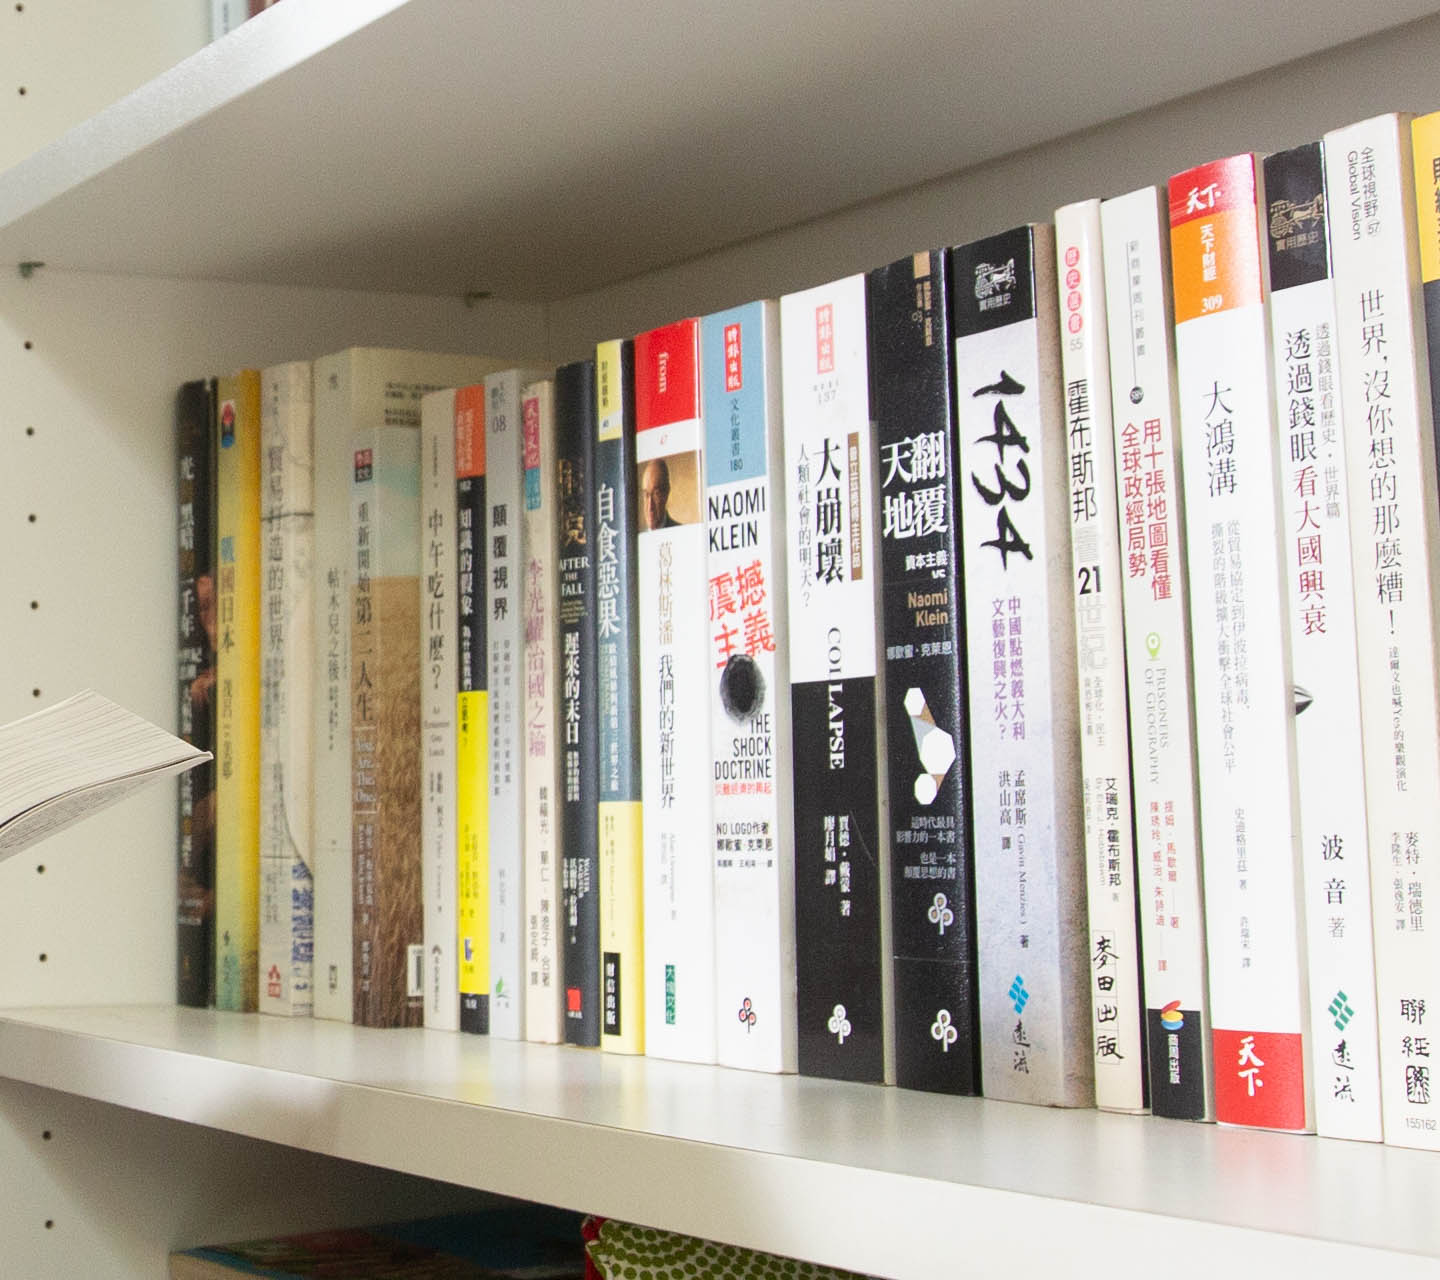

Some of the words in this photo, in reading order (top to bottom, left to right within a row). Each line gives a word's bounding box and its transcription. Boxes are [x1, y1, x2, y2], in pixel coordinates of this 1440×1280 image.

[1186, 182, 1221, 214] 天下
[1361, 146, 1380, 218] 全球視野
[1201, 294, 1223, 313] 309
[657, 351, 670, 393] from
[880, 429, 948, 489] 天翻
[971, 369, 1034, 572] 1434
[1067, 379, 1099, 523] 霍布斯邦
[1202, 380, 1238, 499] 大鴻溝
[708, 486, 767, 521] NAOMI
[814, 438, 845, 585] 大崩壞
[882, 483, 949, 541] 地覆
[1120, 422, 1148, 577] 全球政經局勢
[1143, 417, 1173, 601] 用十張地圖看懂
[1285, 328, 1328, 635] 透過錢眼看大國興衰
[708, 524, 758, 553] KLEIN
[797, 442, 813, 608] 人類社會的明天?
[491, 502, 509, 622] 顛覆視界
[559, 556, 591, 571] AFTER
[561, 581, 585, 596] FALL
[597, 482, 621, 639] 自食惡果
[708, 559, 768, 622] 震撼
[1077, 565, 1102, 595] 21
[427, 508, 447, 690] 中午吃什麼?
[907, 588, 949, 610] Naomi
[915, 609, 949, 628] Klein
[713, 610, 777, 669] 主義
[992, 597, 1008, 740] 文藝復興之火?
[1008, 595, 1026, 741] 中國點燃義大利
[751, 717, 771, 735] THE
[828, 627, 846, 771] COLLAPSE
[1156, 668, 1169, 749] PRISONERS
[714, 759, 772, 781] DOCTRINE
[732, 737, 772, 758] SHOCK
[998, 770, 1012, 825] 洪山高
[919, 851, 957, 865] 也是一本
[1104, 777, 1122, 887] 艾瑞克·霍布斯邦
[1321, 833, 1347, 906] 波音
[1092, 933, 1125, 1061] 麥田出版
[1399, 998, 1431, 1058] 聯經
[1237, 1035, 1265, 1097] 天下
